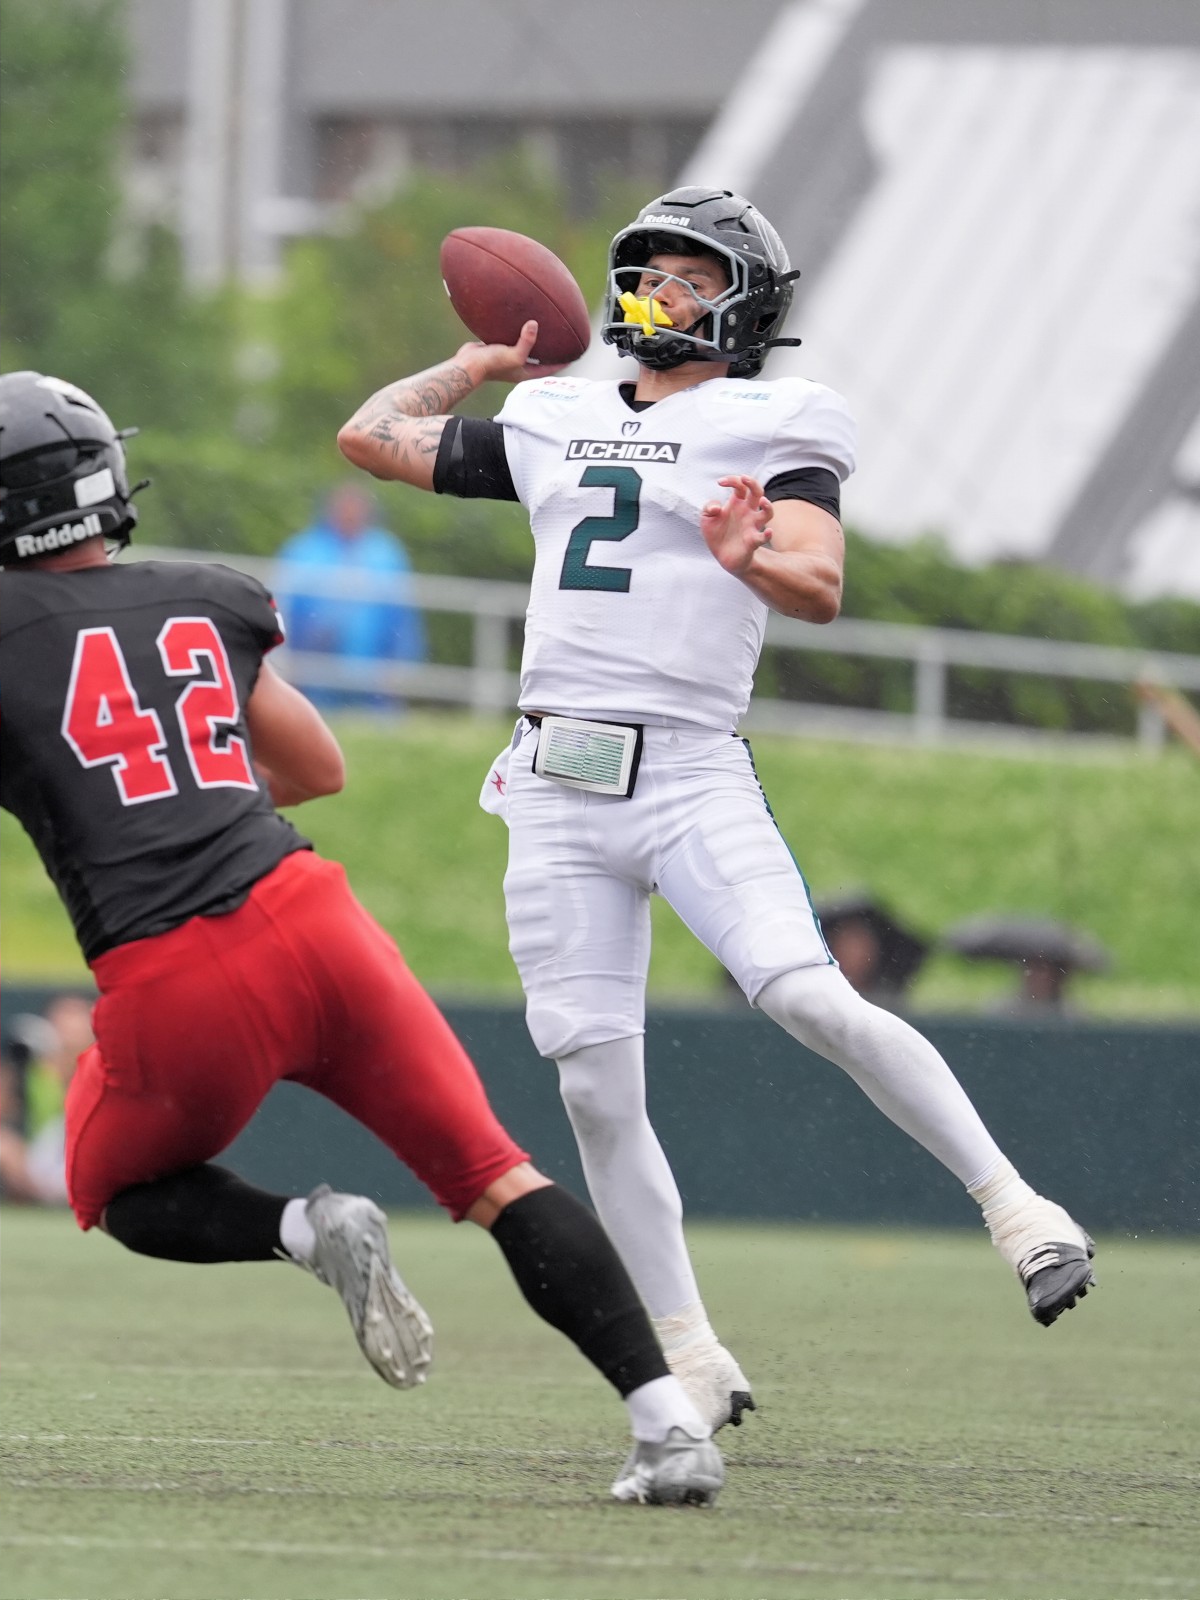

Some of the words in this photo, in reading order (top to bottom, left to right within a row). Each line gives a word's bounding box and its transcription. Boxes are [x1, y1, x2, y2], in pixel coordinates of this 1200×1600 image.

[642, 214, 691, 227] Riddell
[568, 441, 676, 462] UCHIDA
[14, 512, 103, 558] Riddell
[558, 465, 643, 593] 2
[60, 616, 259, 807] 42
